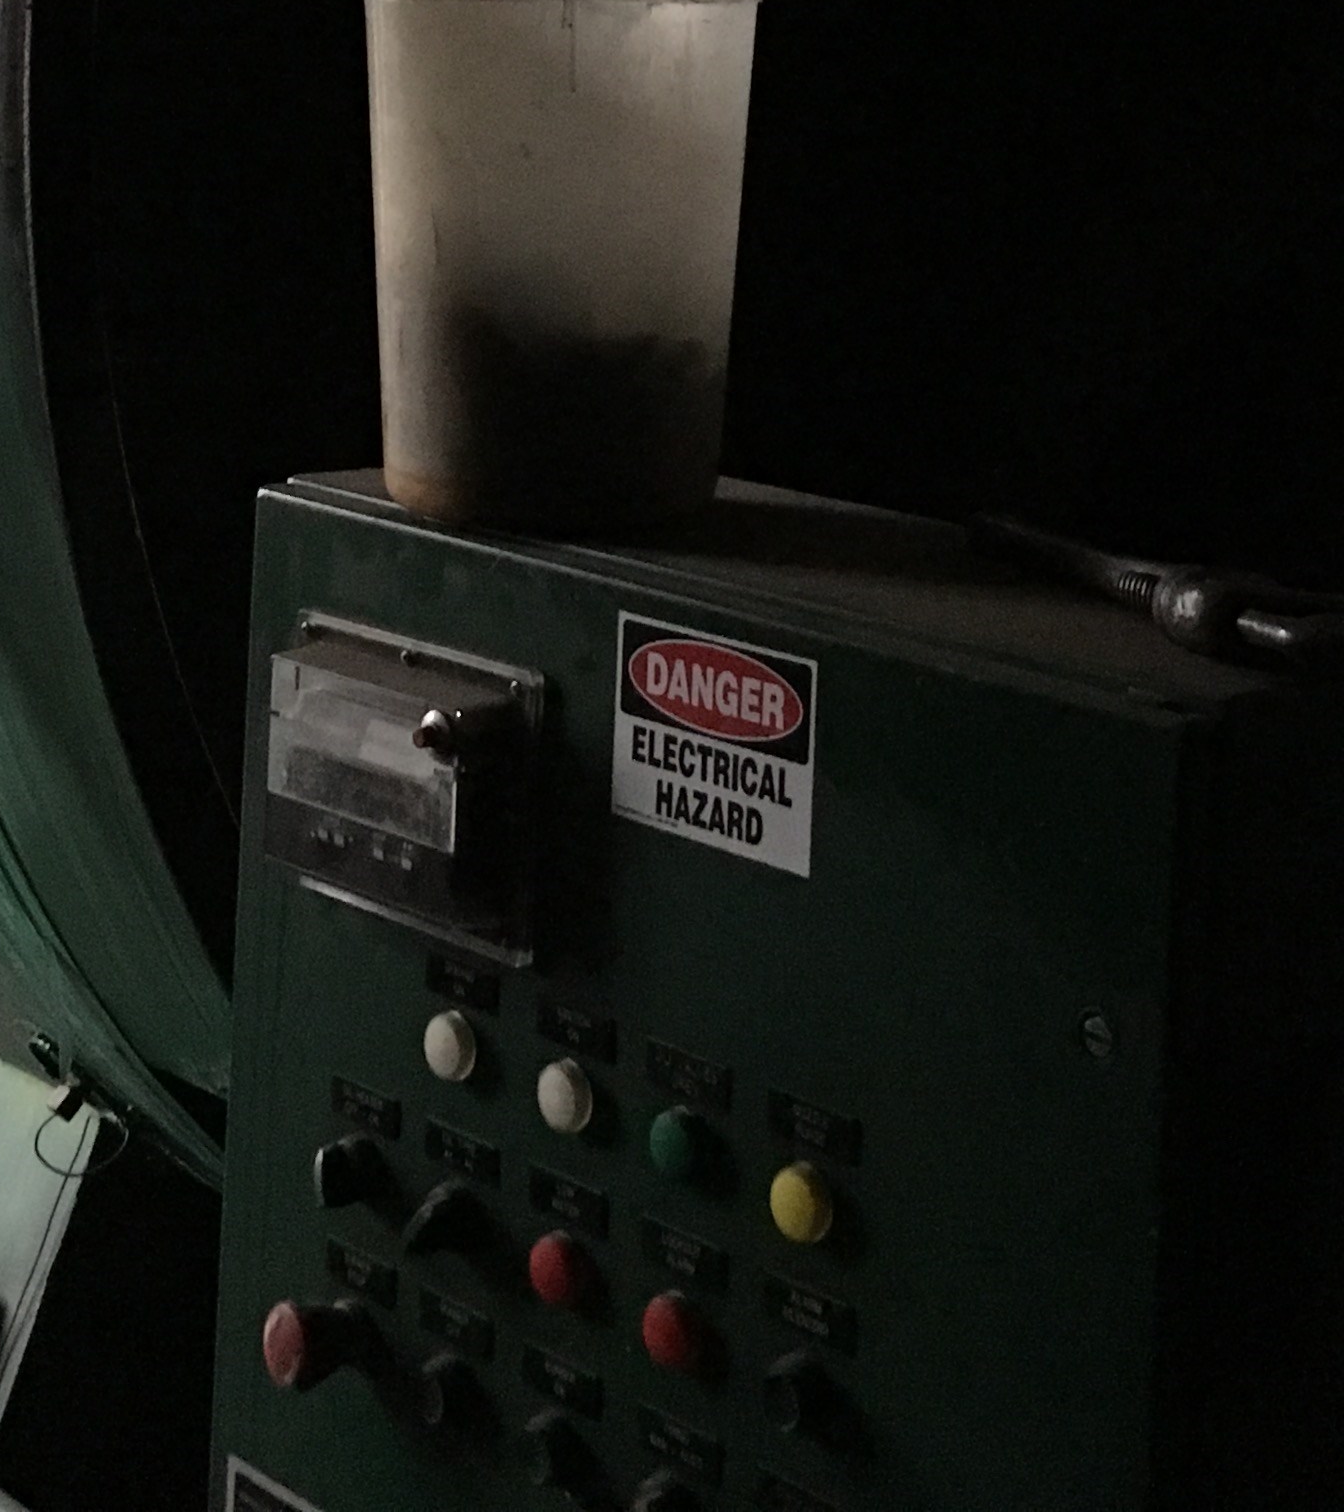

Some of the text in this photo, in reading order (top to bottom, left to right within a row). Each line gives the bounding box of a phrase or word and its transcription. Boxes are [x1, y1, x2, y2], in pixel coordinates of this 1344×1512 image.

[646, 651, 785, 731] DANGER
[632, 725, 792, 807] ELECTRICAL
[656, 779, 763, 845] HAZARD
